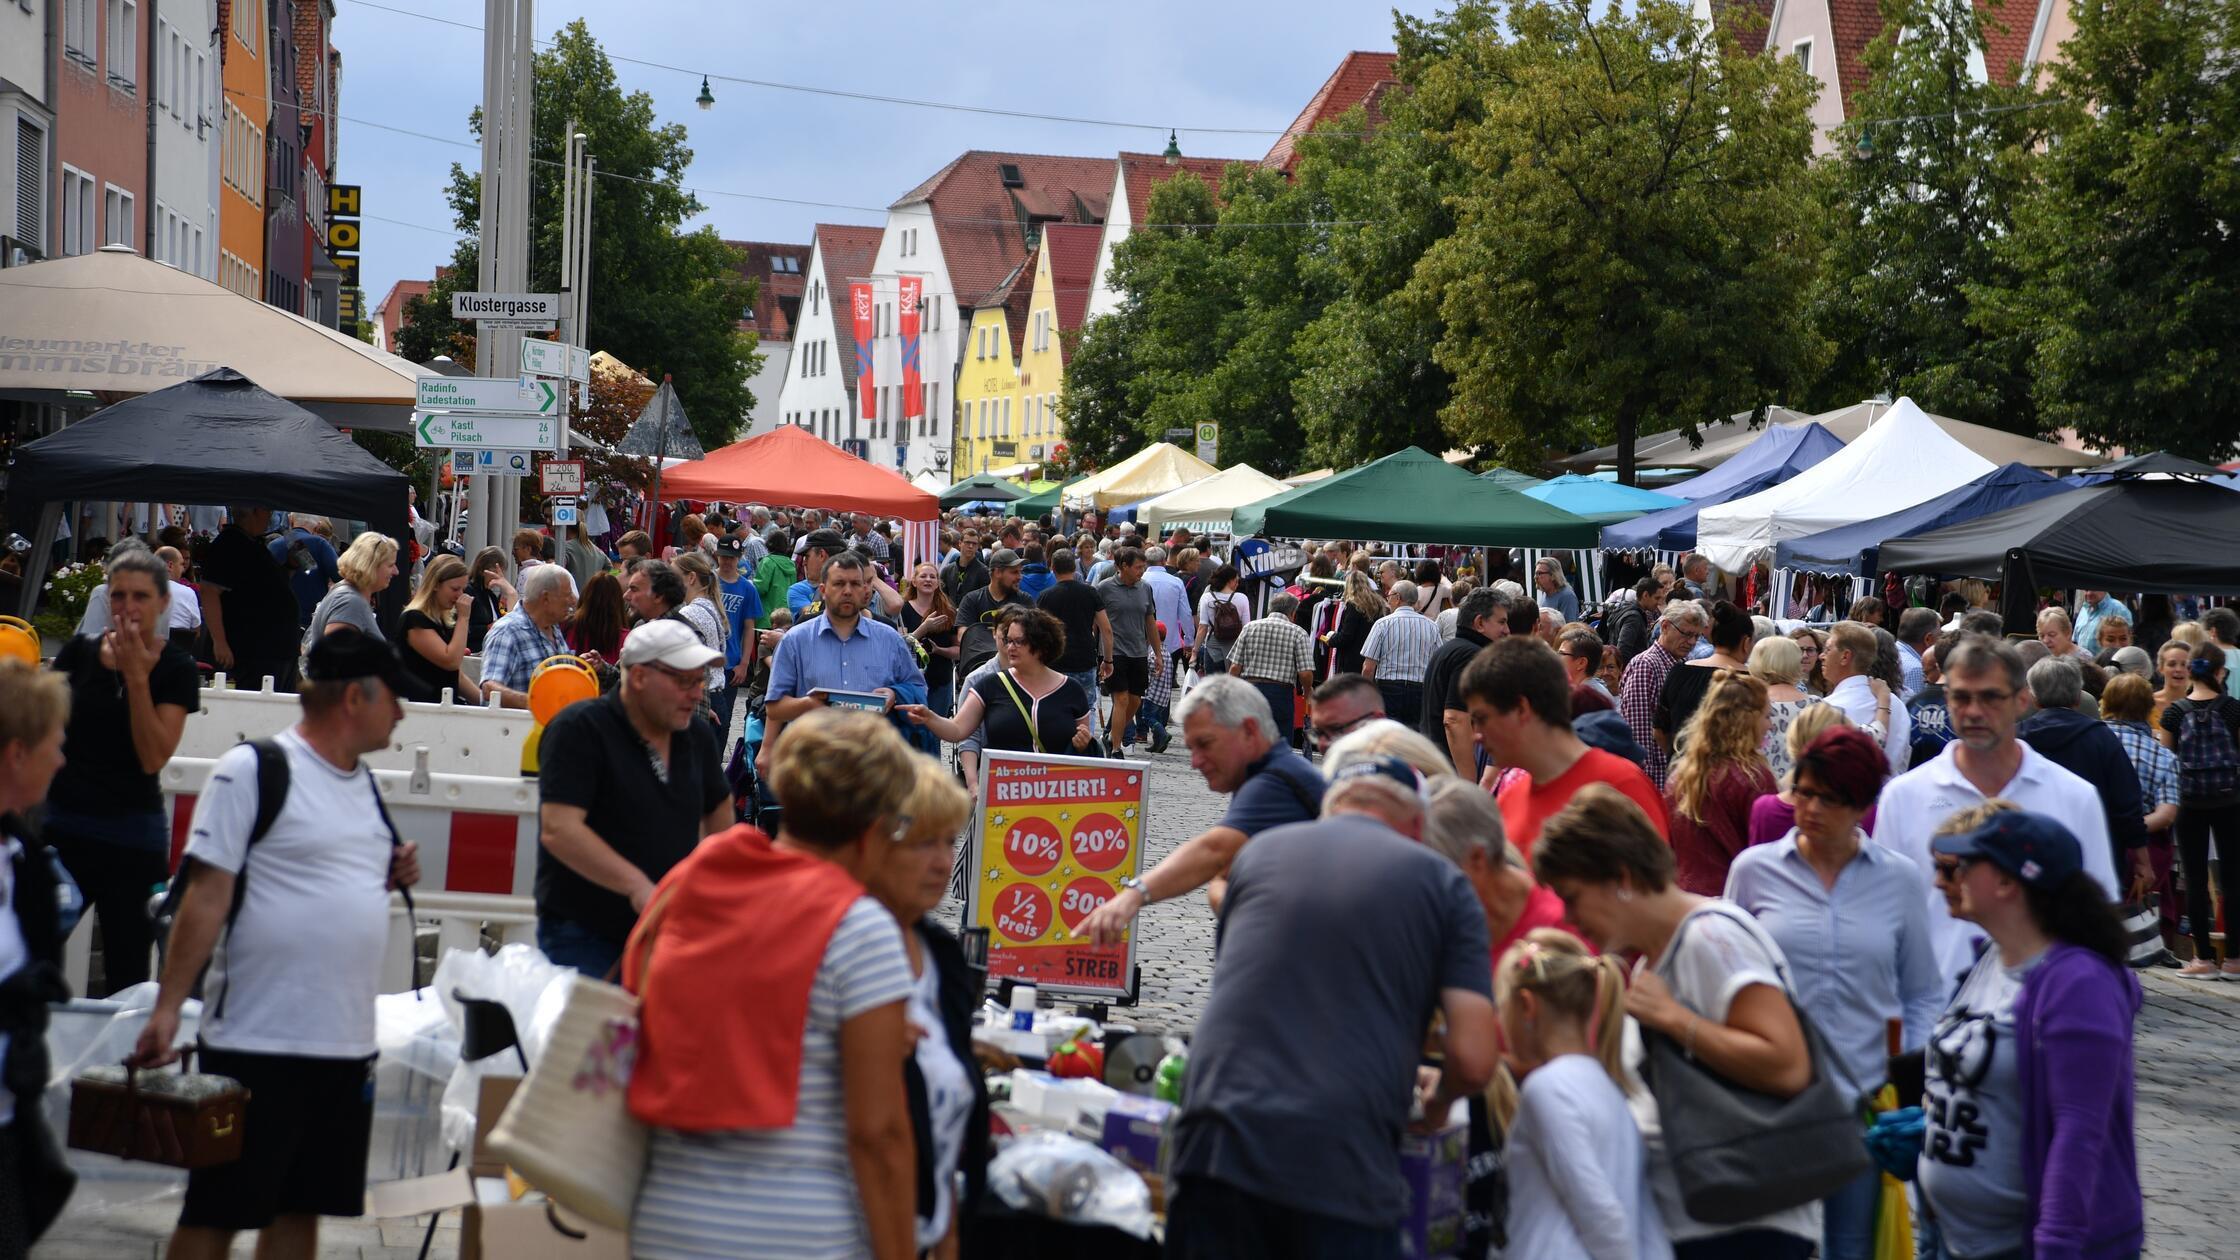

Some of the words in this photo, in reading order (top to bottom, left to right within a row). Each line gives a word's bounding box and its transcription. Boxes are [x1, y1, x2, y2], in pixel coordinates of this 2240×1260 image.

[329, 188, 359, 317] HOTE
[459, 296, 547, 317] Klostergasse
[421, 382, 457, 393] Radinfo
[421, 394, 476, 406] Ladestation
[451, 420, 474, 430] Kastl
[538, 423, 548, 432] 26
[451, 432, 482, 442] Pilsach
[557, 464, 573, 472] 200
[1240, 546, 1297, 579] prince
[720, 593, 745, 613] IKE
[1916, 710, 1945, 729] 1944
[996, 766, 1010, 777] Ab
[1014, 765, 1047, 776] sofort
[996, 778, 1106, 800] REDUZIERT!
[1010, 829, 1059, 861] 10%
[1074, 828, 1126, 854] 20%
[998, 914, 1038, 937] Preis
[1065, 958, 1119, 979] STREB
[1931, 1096, 1989, 1137] AR
[1927, 1131, 1987, 1168] RS
